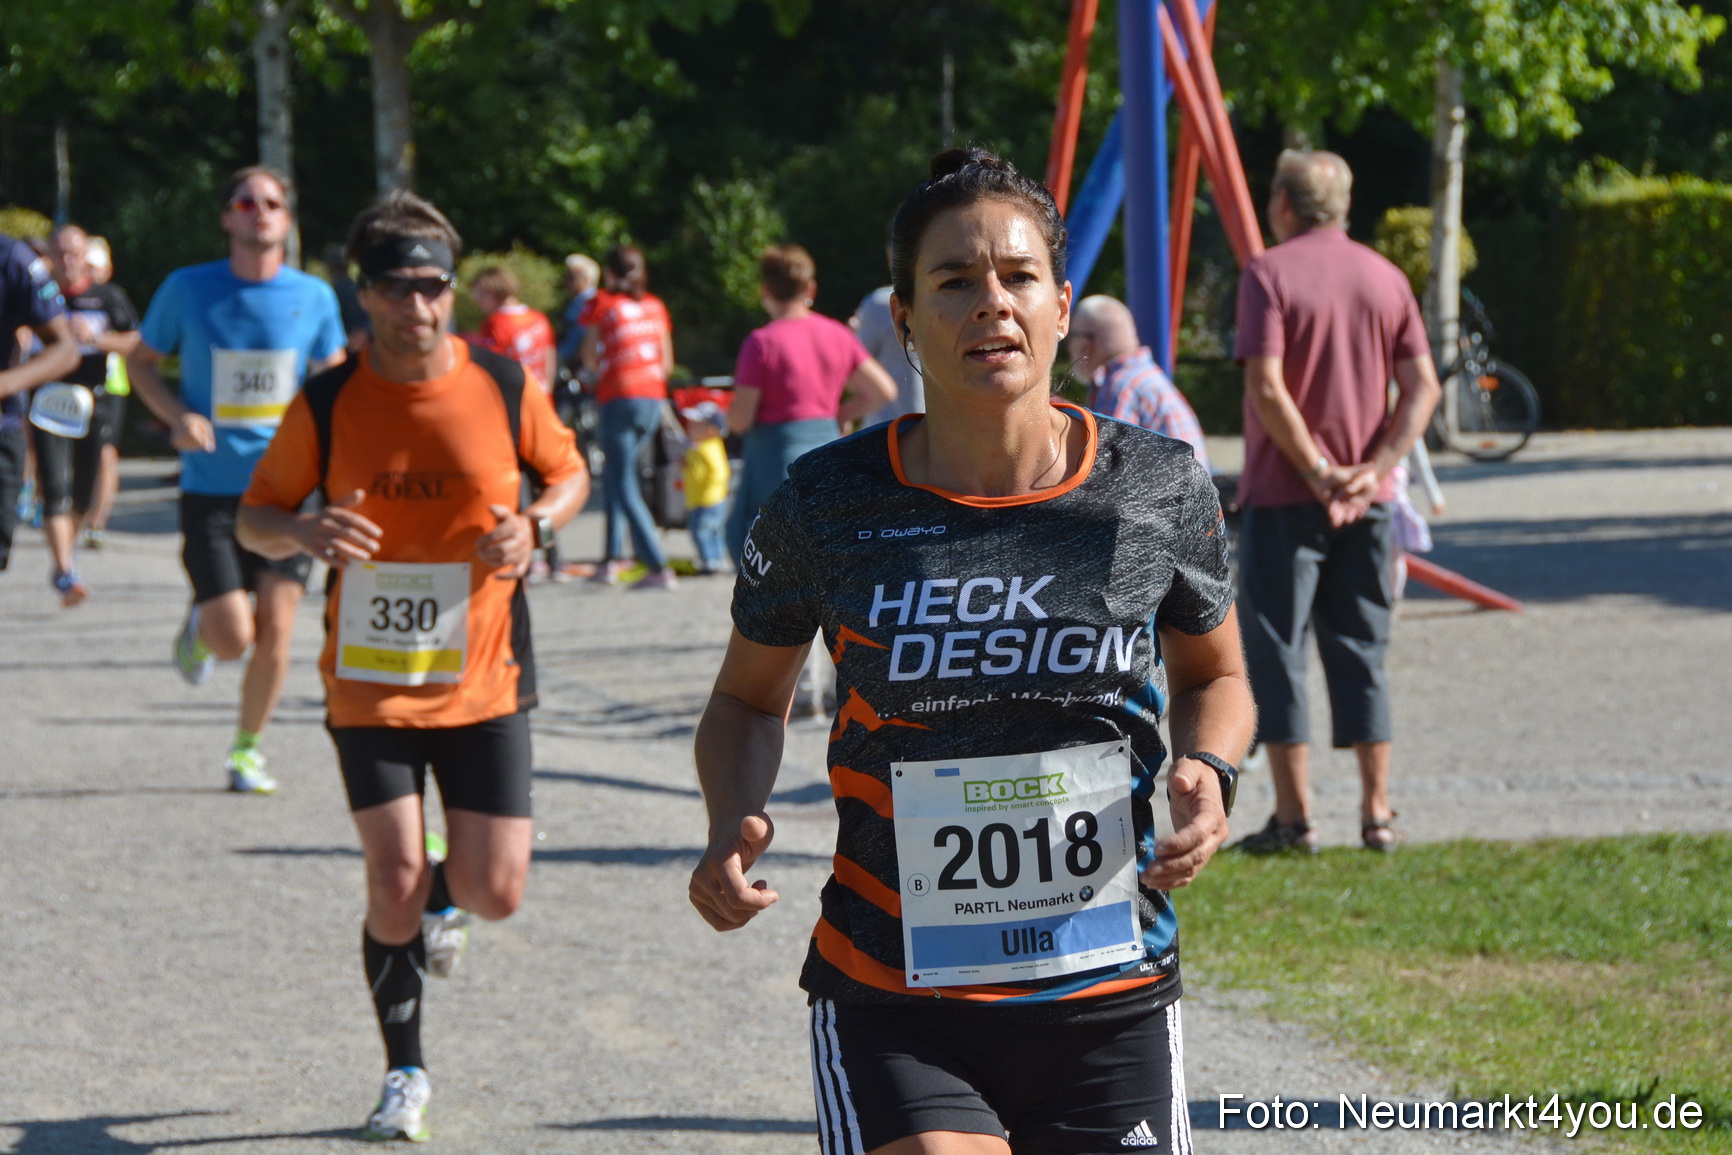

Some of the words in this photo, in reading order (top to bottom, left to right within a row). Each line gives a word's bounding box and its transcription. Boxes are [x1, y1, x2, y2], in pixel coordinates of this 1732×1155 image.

[233, 370, 275, 393] 340
[370, 596, 438, 632] 330
[868, 574, 1056, 628] HECK
[888, 626, 1143, 682] DESIGN
[963, 772, 1068, 804] BOCK
[965, 804, 997, 813] inspired
[999, 803, 1009, 812] by
[1010, 801, 1034, 809] smart
[1035, 796, 1070, 807] concepts
[933, 811, 1103, 891] 2018
[914, 879, 923, 892] B
[954, 901, 1005, 915] PARTL
[1008, 891, 1075, 912] Neumarkt
[1001, 926, 1055, 957] Ulla
[1121, 1135, 1157, 1146] adidas
